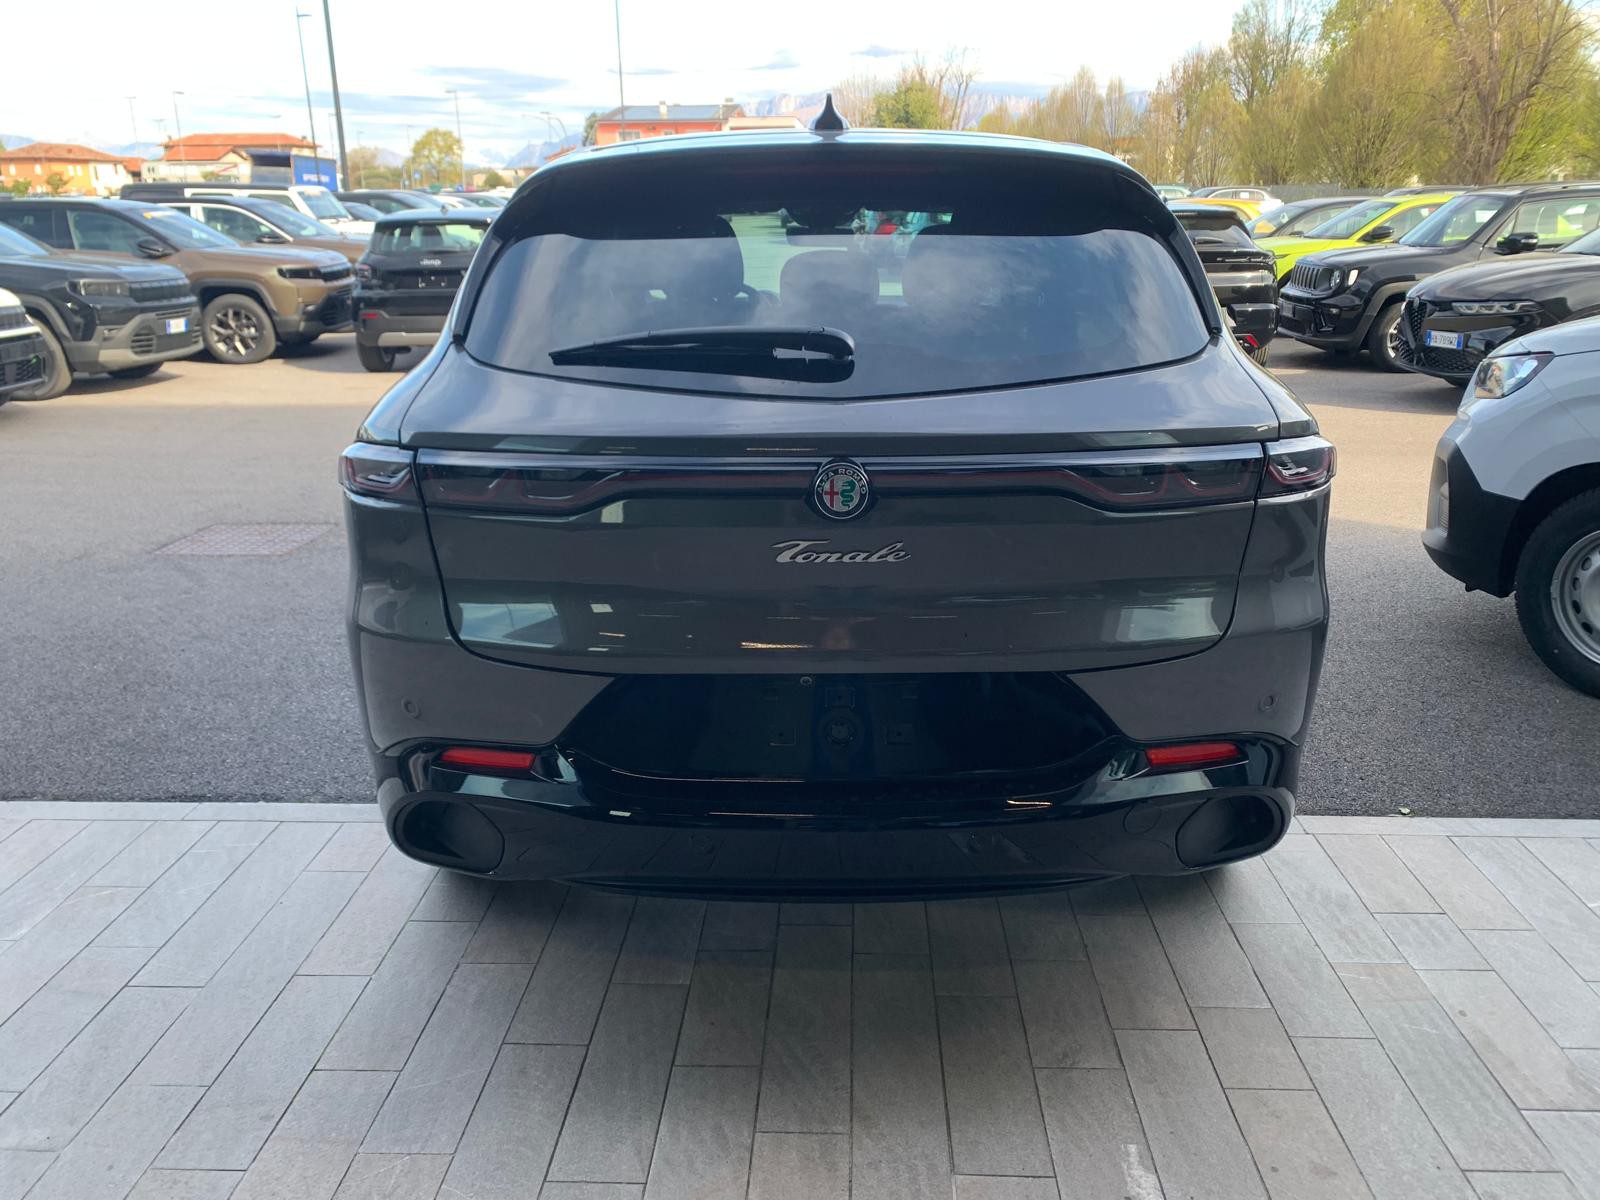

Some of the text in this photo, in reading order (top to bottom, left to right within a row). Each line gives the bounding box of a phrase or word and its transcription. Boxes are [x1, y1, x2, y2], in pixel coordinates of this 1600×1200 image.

[817, 468, 867, 494] ALFA ROMEO
[771, 539, 912, 563] Tonale
